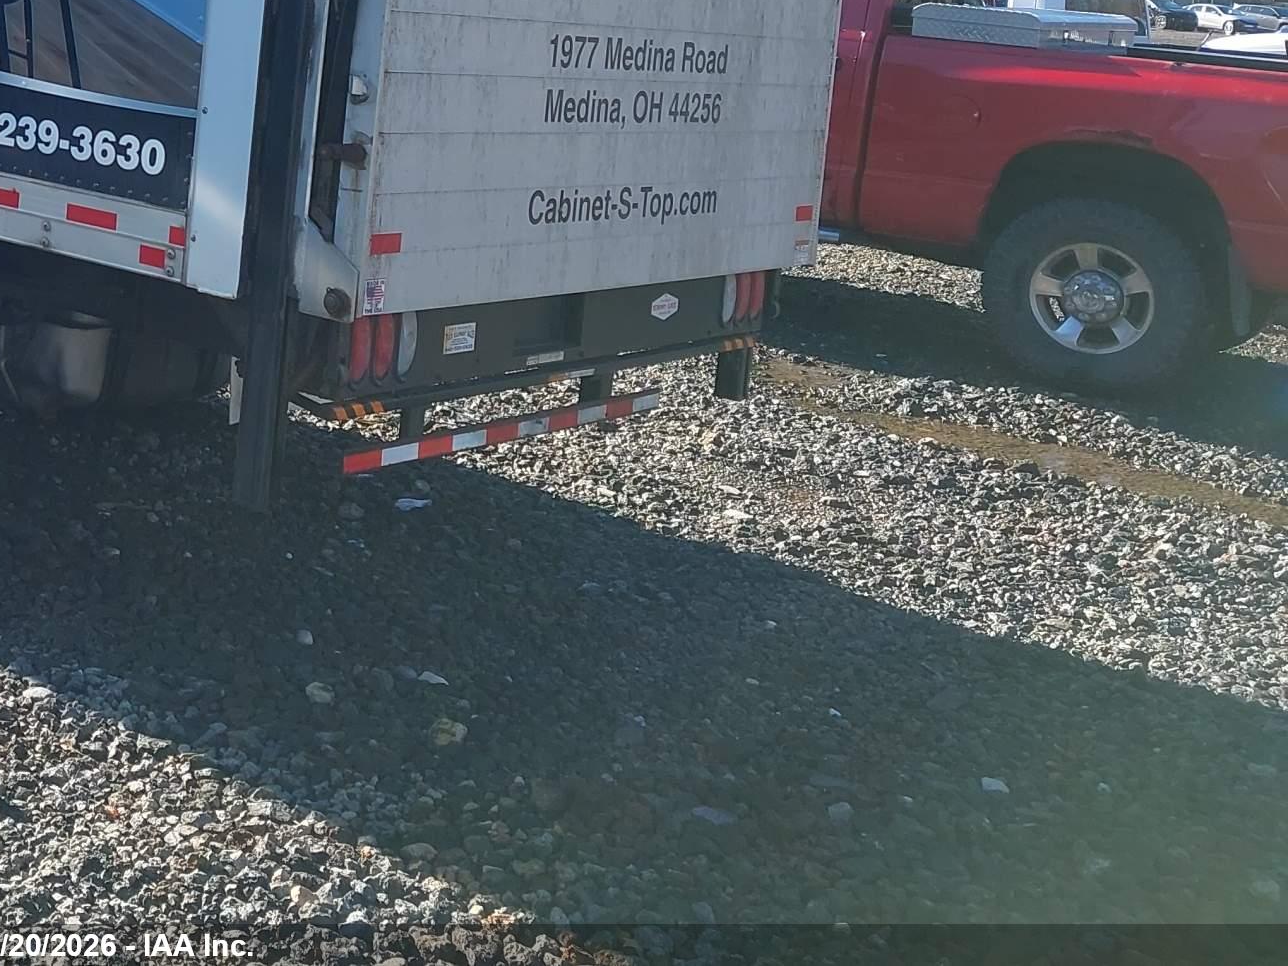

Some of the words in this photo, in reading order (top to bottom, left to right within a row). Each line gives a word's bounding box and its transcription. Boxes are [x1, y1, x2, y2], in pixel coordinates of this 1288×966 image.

[549, 33, 600, 70] 1977
[604, 36, 677, 74] Medina
[681, 41, 729, 75] Road
[544, 88, 627, 130] Medina,
[633, 90, 665, 125] OH
[668, 90, 722, 124] 44256
[527, 185, 718, 227] Cabinet-S-Top.com
